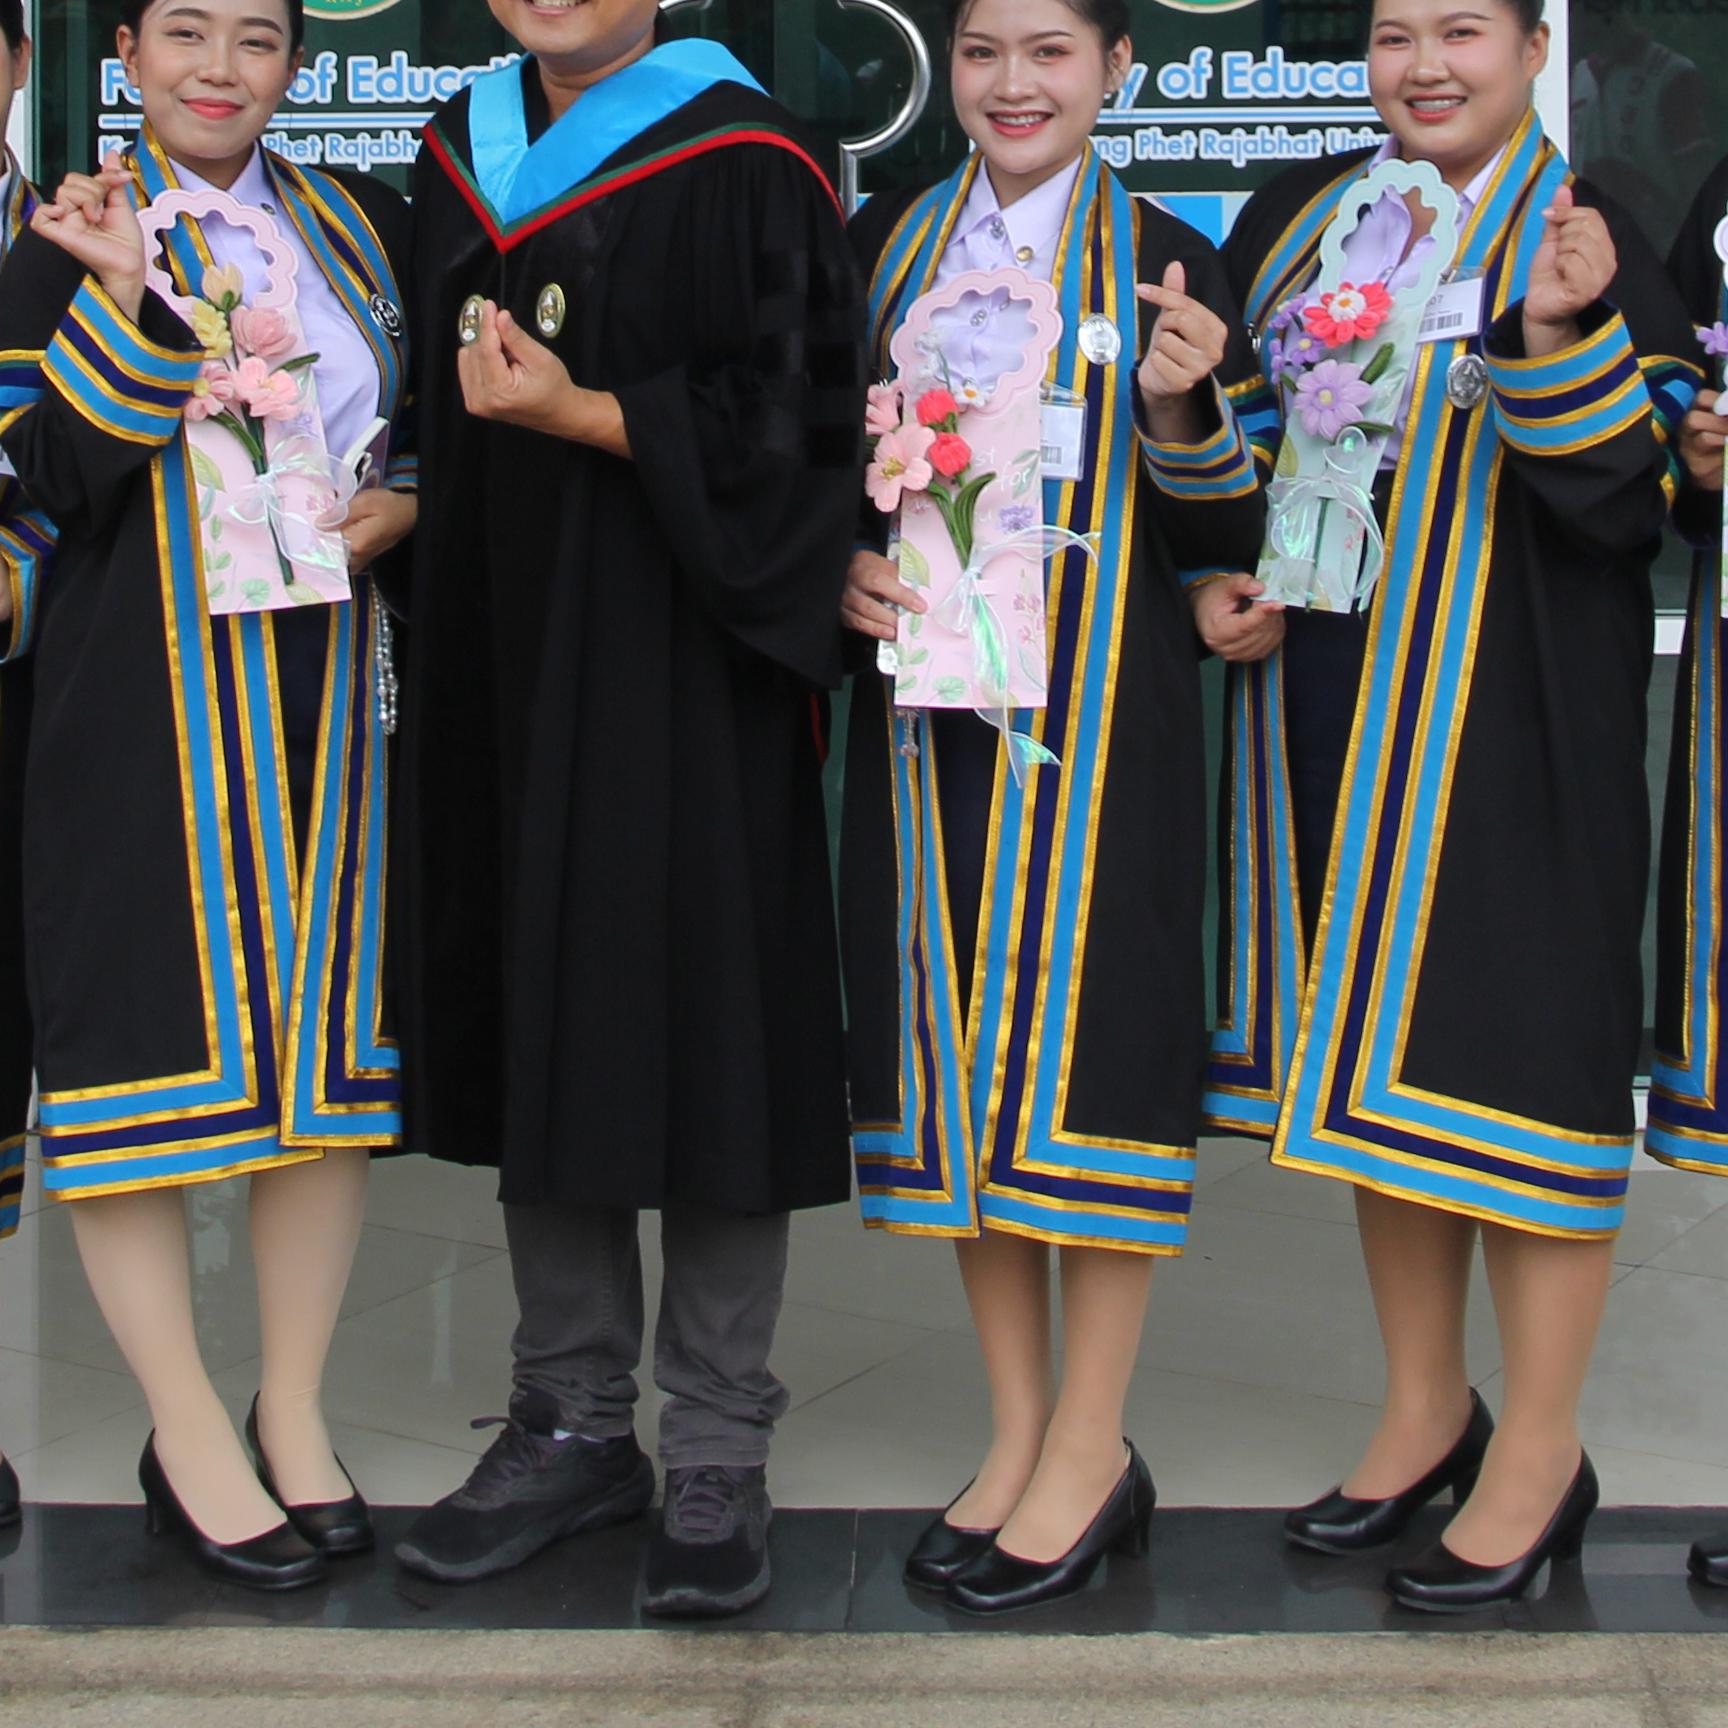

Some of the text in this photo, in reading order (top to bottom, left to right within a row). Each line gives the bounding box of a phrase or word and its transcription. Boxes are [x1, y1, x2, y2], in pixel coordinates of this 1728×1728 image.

[287, 51, 338, 104] of
[1159, 47, 1213, 98] of
[1223, 46, 1370, 99] Educa
[326, 130, 422, 171] Rajabh
[1136, 127, 1197, 160] Phet
[1200, 126, 1322, 167] Rajabhat
